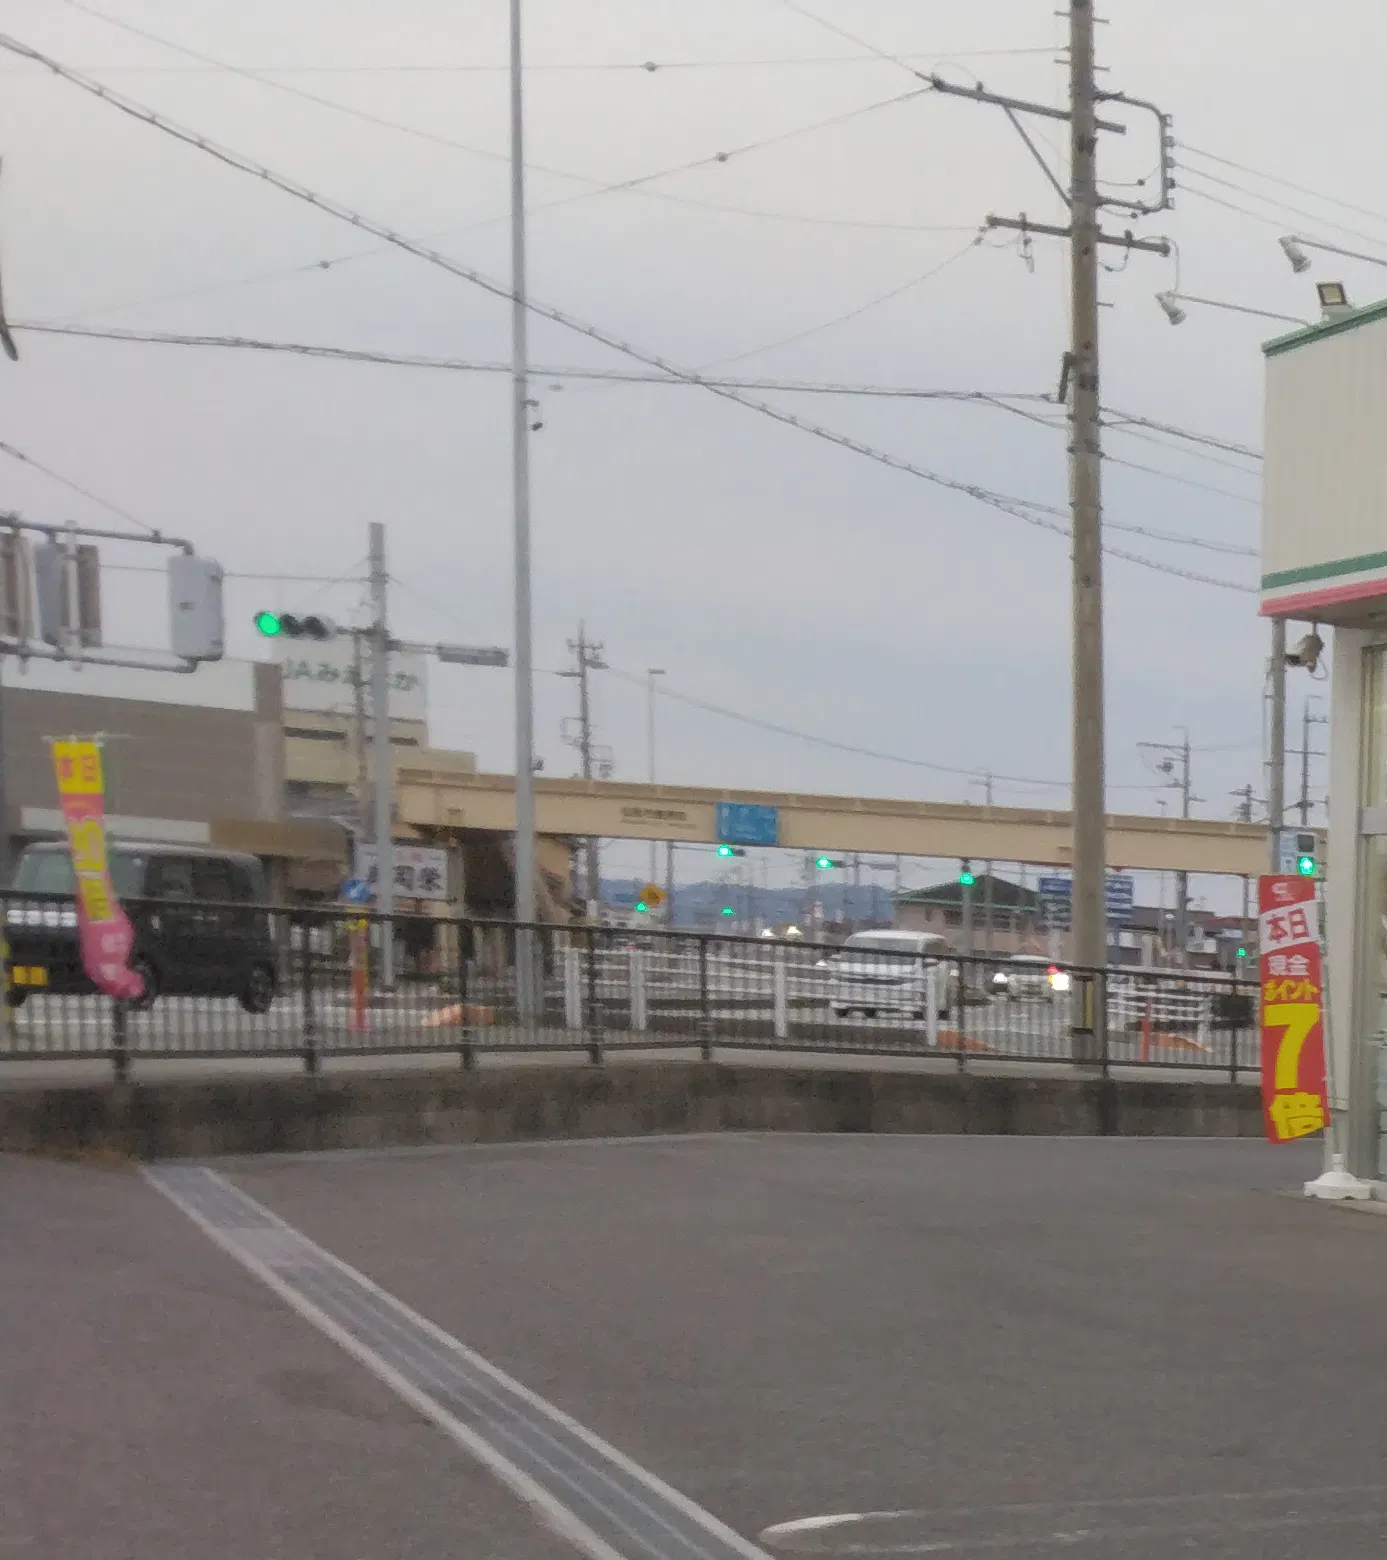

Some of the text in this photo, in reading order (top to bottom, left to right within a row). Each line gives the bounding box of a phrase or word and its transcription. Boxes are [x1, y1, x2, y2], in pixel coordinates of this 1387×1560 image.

[1263, 978, 1319, 1002] ポイント
[1263, 1003, 1320, 1090] 7
